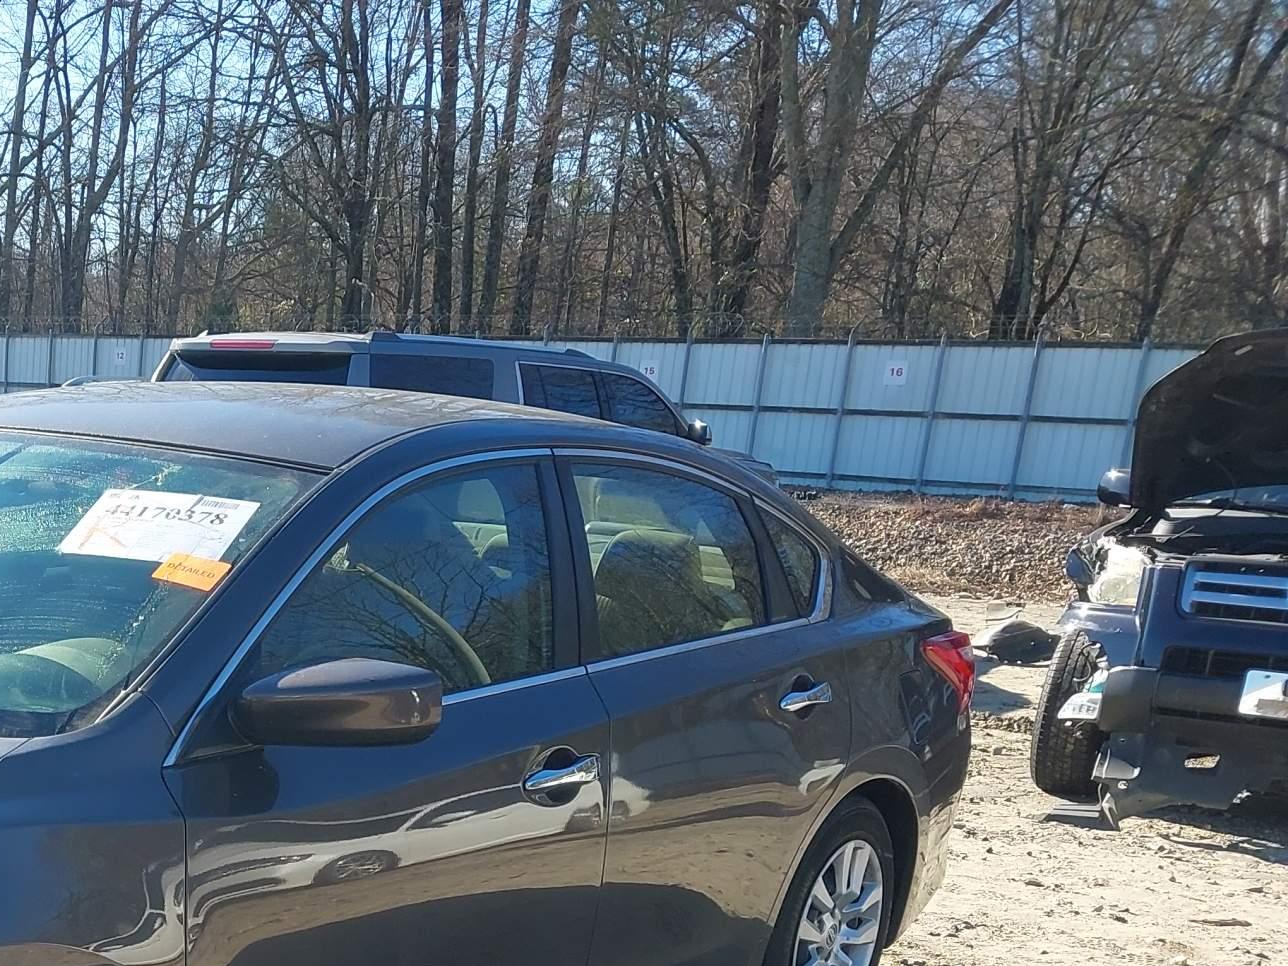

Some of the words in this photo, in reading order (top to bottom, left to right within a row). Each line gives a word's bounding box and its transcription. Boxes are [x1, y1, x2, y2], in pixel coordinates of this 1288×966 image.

[644, 366, 656, 375] 15
[890, 367, 904, 377] 16
[106, 503, 229, 526] 44170378
